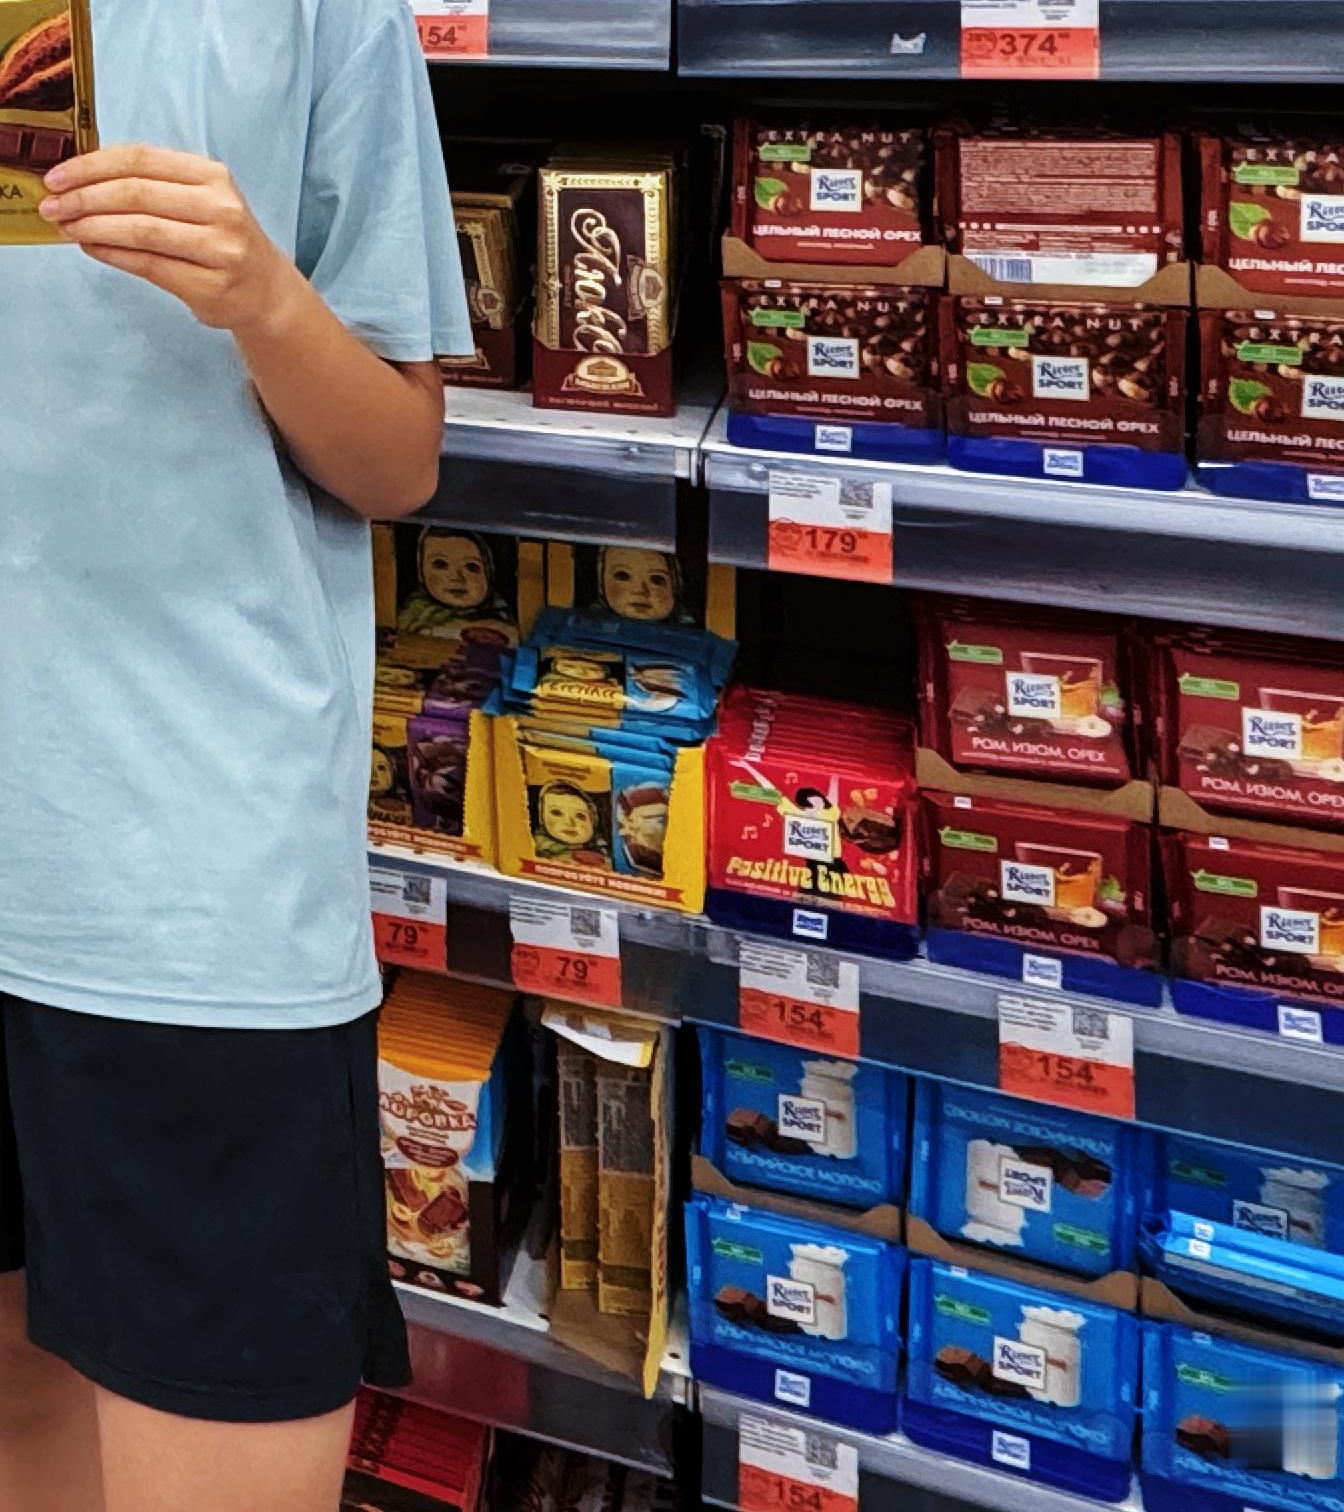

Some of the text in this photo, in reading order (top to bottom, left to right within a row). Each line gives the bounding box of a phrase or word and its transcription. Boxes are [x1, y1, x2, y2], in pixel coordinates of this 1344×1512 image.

[999, 33, 1057, 57] 374
[768, 131, 911, 145] EXTRA NUT
[1246, 150, 1342, 164] EXTRA
[761, 296, 908, 313] EXTRA NUT
[980, 313, 1140, 332] EXTRA NUT
[1250, 328, 1344, 346] EXTRA
[726, 858, 897, 908] Positive Energy
